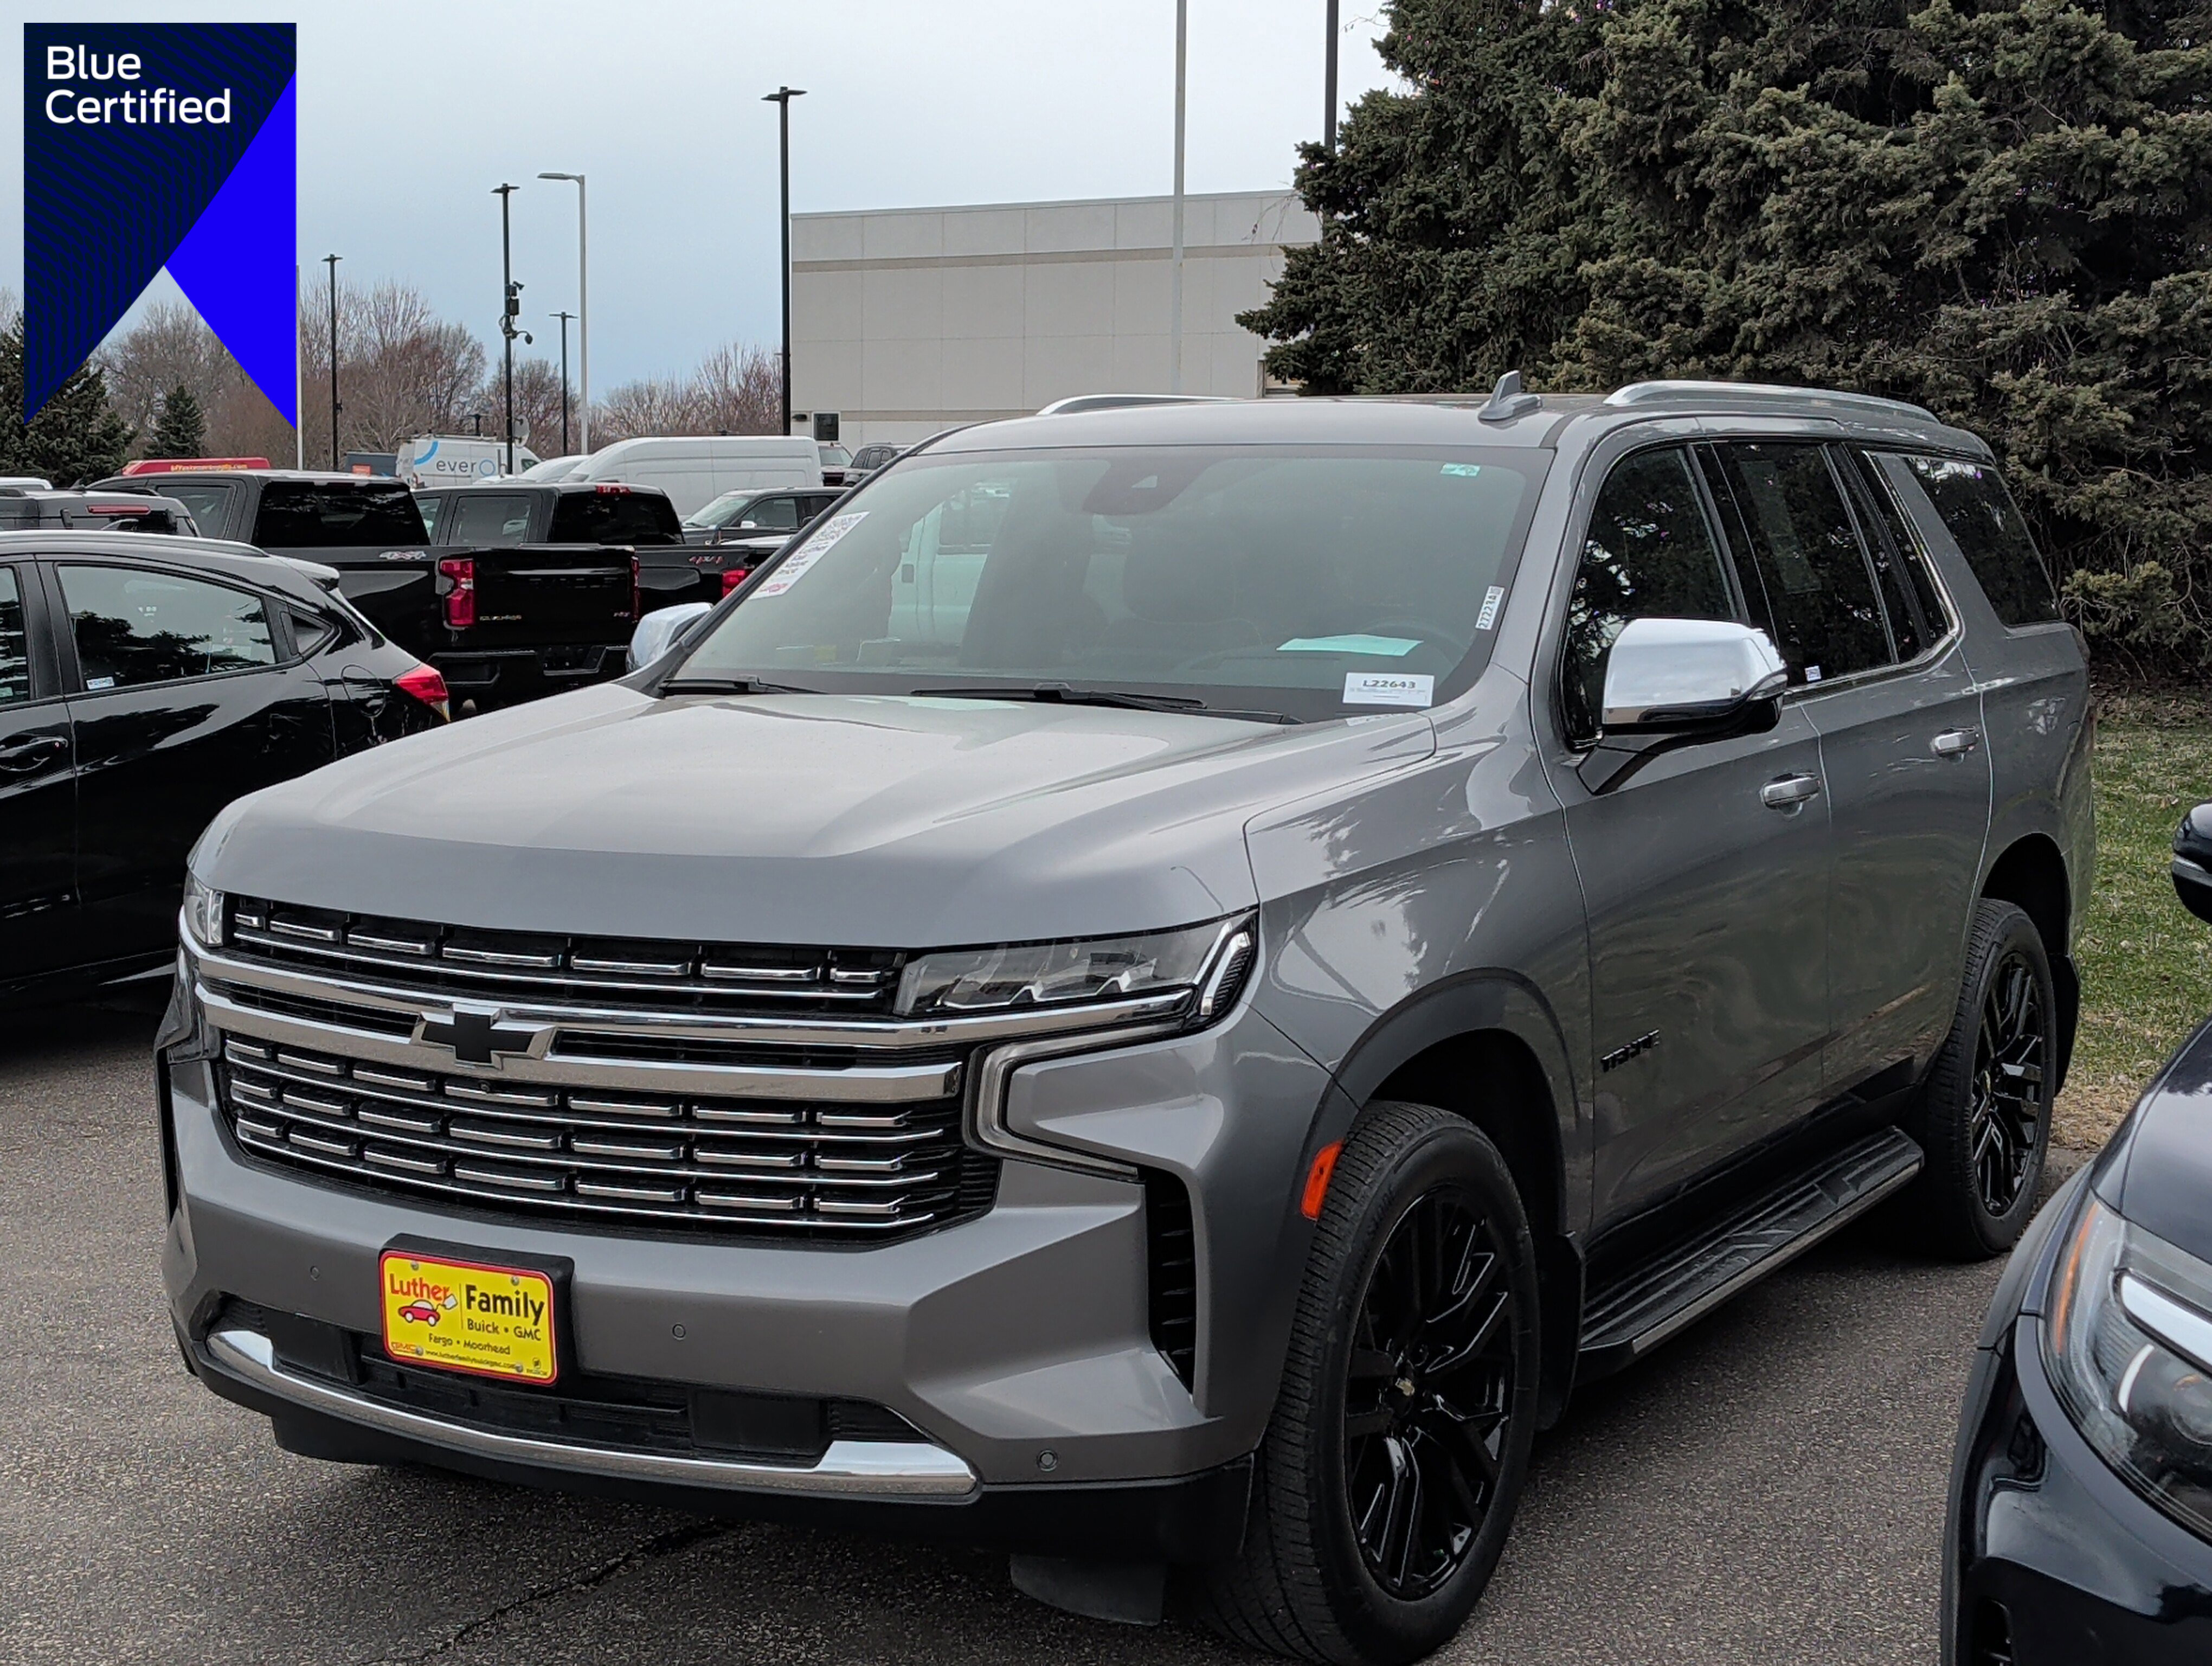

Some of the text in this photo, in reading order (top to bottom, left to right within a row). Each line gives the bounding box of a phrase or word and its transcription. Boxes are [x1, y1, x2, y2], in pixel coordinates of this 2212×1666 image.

[1362, 680, 1416, 689] L22643
[390, 1273, 545, 1327] Luther Family
[467, 1318, 541, 1341] Buick GMC
[429, 1333, 510, 1355] Fargo Moorhead
